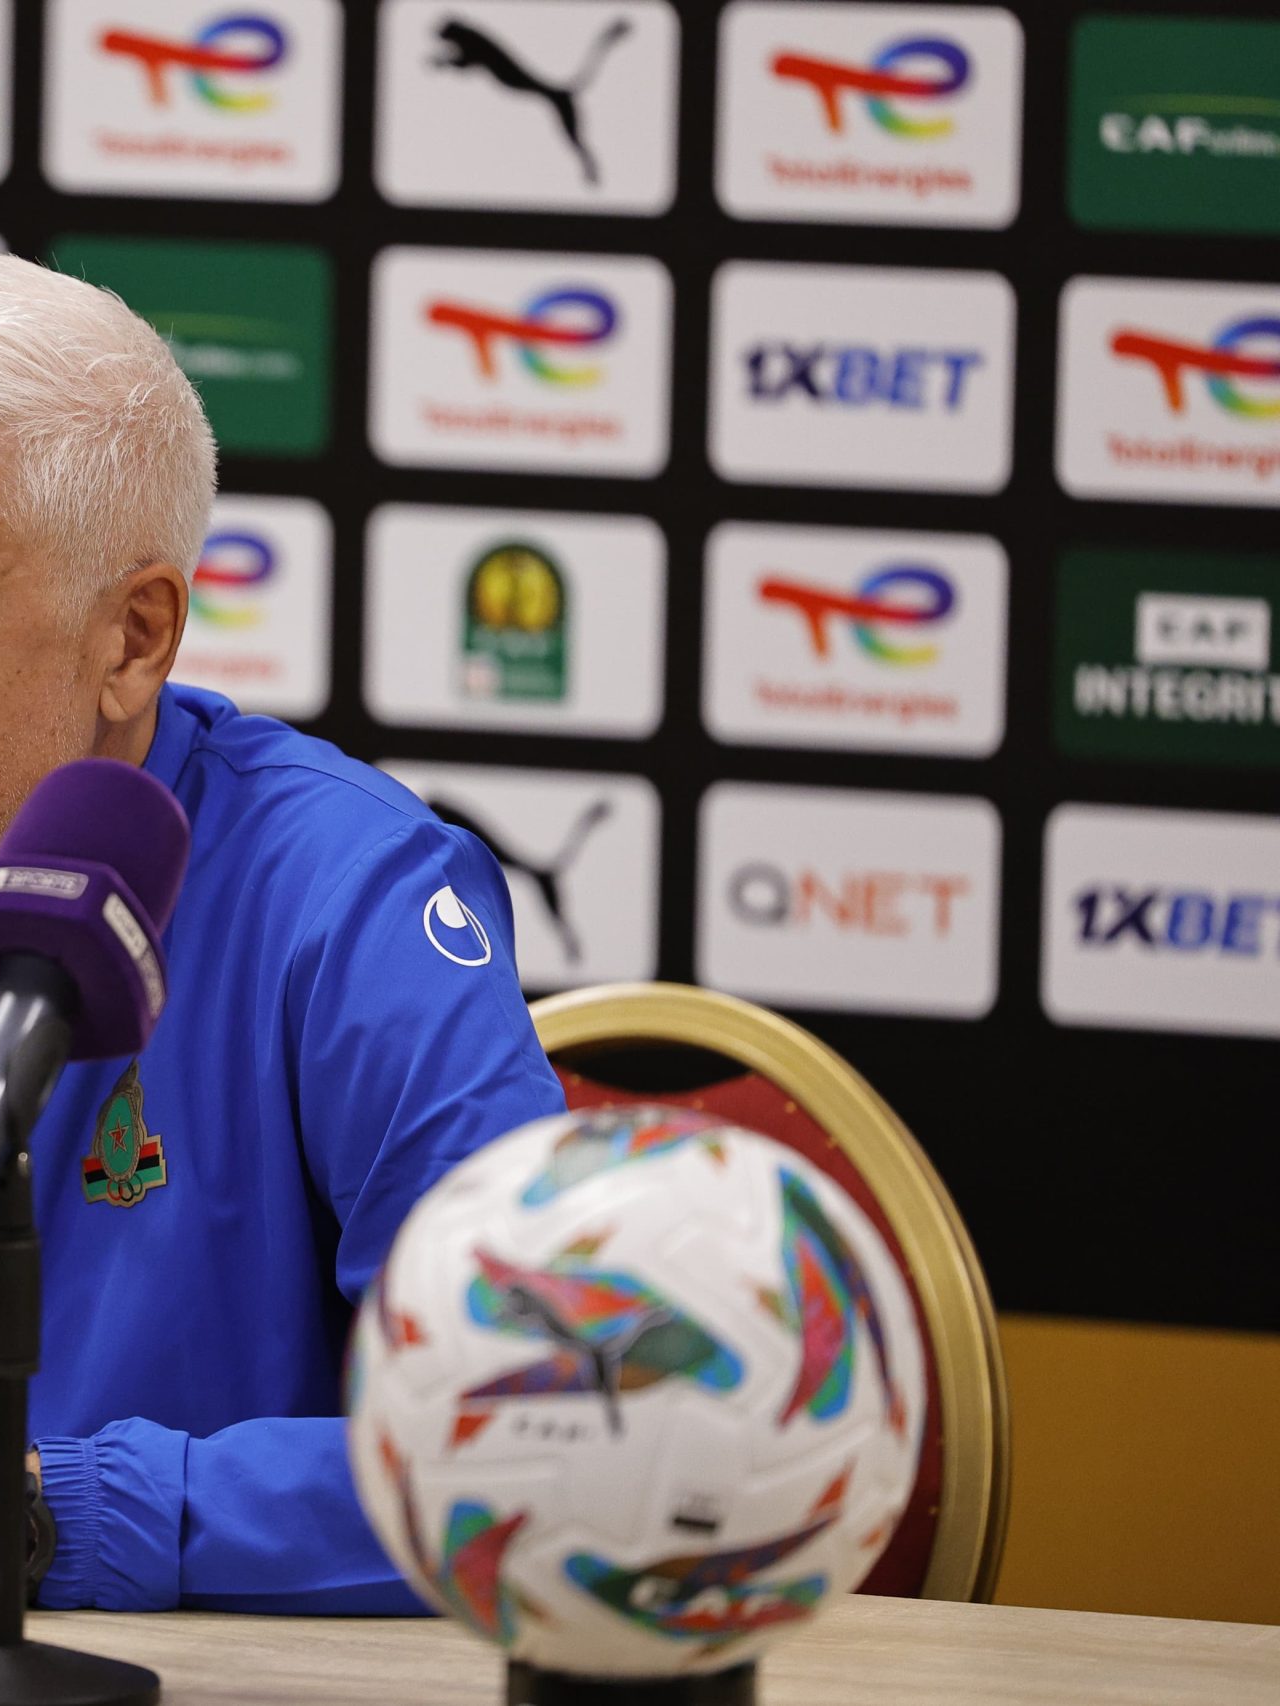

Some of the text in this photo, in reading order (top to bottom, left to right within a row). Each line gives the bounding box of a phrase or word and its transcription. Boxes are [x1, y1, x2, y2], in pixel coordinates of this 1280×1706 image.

[743, 342, 982, 411] 1XBET
[727, 862, 970, 938] QNET
[1074, 885, 1280, 957] 1XBE
